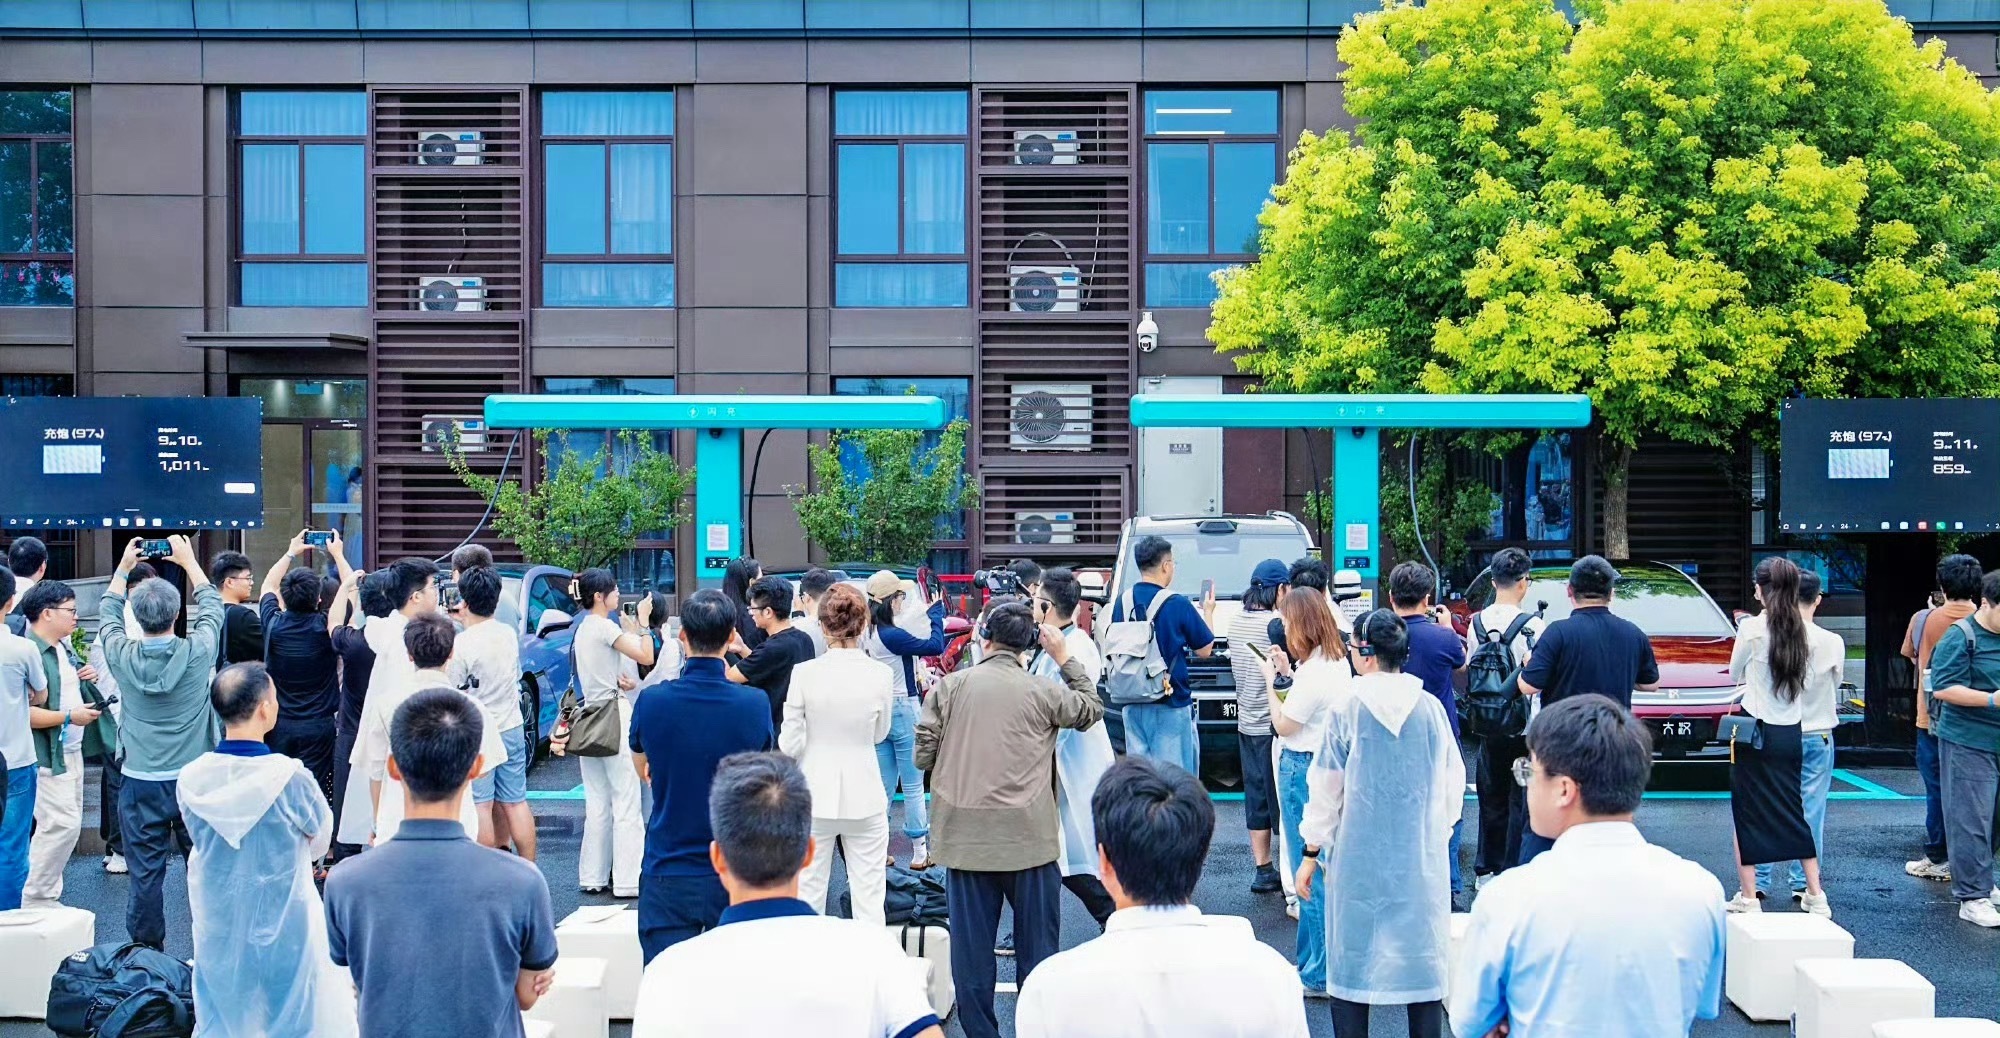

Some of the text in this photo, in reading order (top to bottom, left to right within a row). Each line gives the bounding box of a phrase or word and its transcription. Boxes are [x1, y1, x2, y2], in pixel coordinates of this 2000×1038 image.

[44, 428, 69, 440] 充饱
[1829, 430, 1856, 442] 充饱
[1223, 702, 1240, 717] 豹
